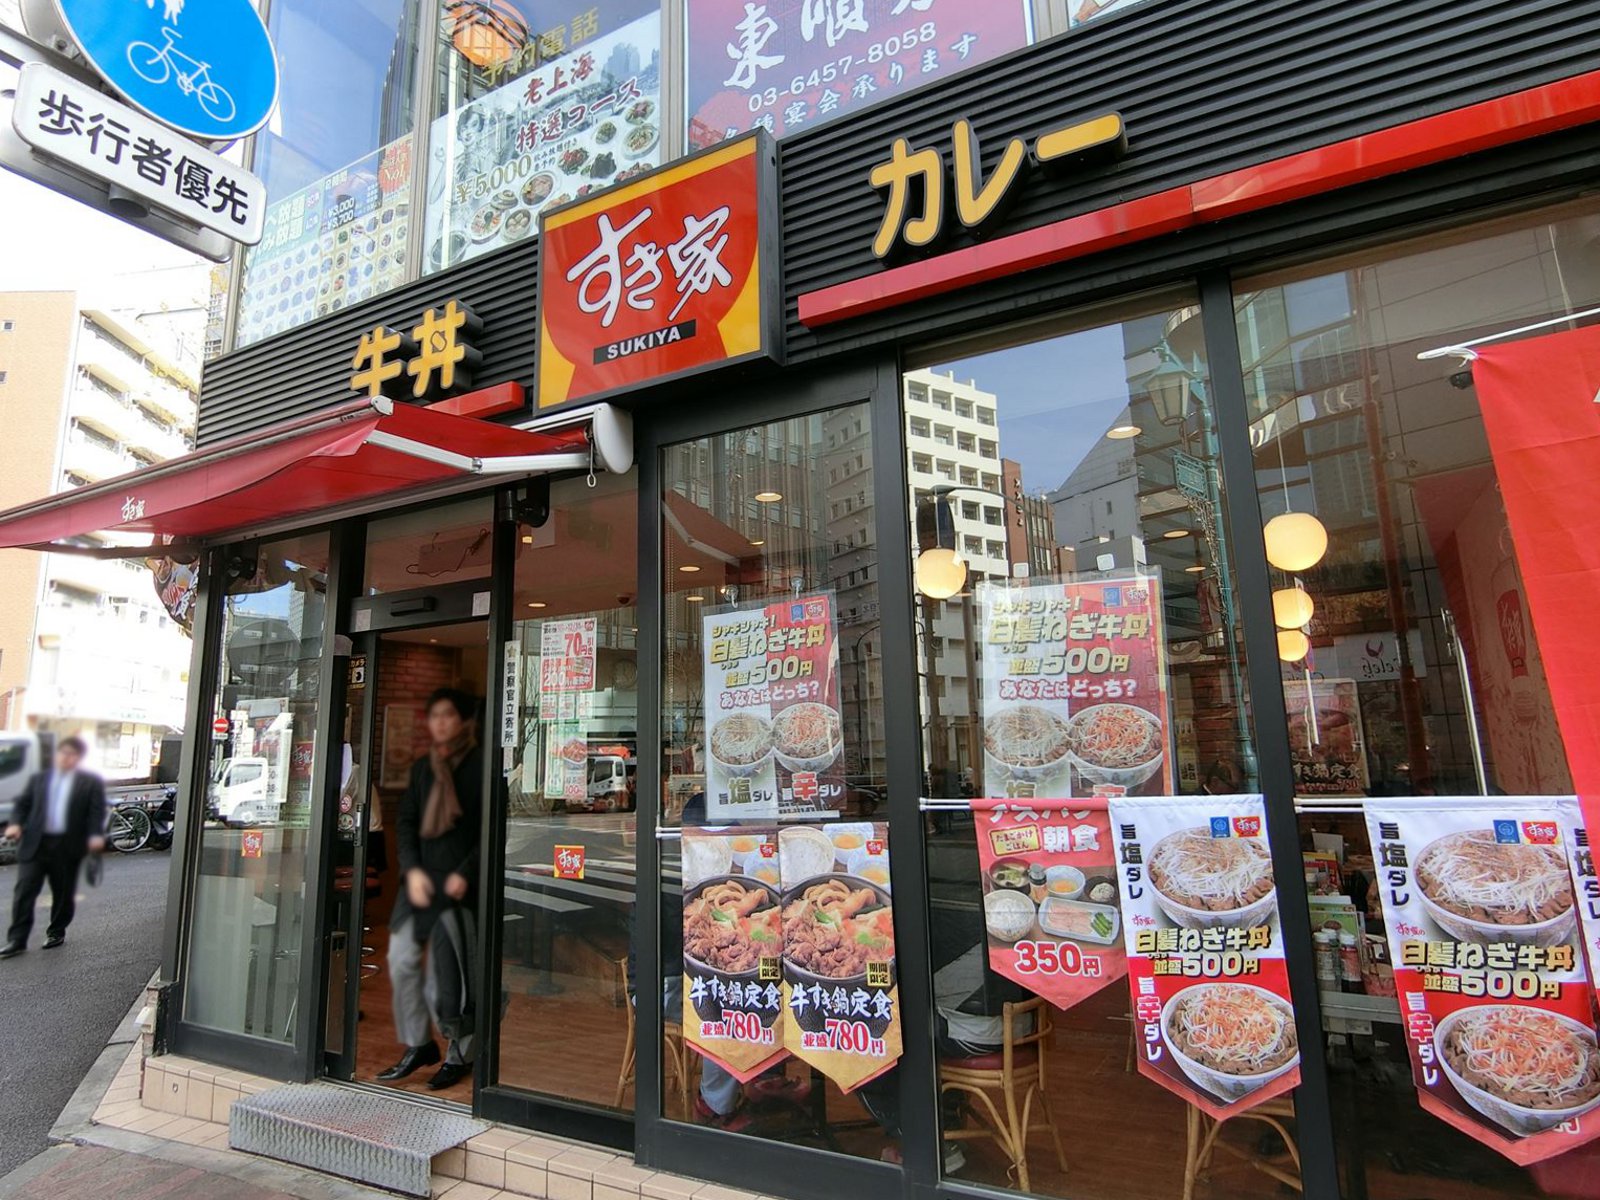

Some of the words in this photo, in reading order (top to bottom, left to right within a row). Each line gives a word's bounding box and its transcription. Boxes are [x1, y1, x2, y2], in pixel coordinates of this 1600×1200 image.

[724, 0, 934, 89] 東順
[523, 51, 595, 106] 老上海
[749, 22, 937, 112] 03-6457-8058
[515, 76, 642, 152] 特選コース
[38, 89, 249, 226] 歩行者優先
[868, 111, 1123, 258] カレー
[566, 205, 733, 328] すき家
[351, 299, 467, 399] 牛丼
[606, 326, 682, 360] SUKIYA
[710, 625, 826, 664] 白髪ねぎ牛丼
[987, 612, 1151, 646] 白髪ねぎ牛丼
[725, 655, 814, 688] 並盛500円
[1009, 646, 1130, 676] 並盛500円
[720, 680, 820, 709] あなたはどっち?
[999, 678, 1139, 700] あなたはどっち?
[1042, 824, 1101, 853] 朝食
[557, 848, 581, 870] すき家
[1120, 823, 1143, 900] 旨塩ダレ
[1379, 821, 1411, 907] 旨塩ダレ
[1013, 940, 1102, 977] 350円
[1134, 925, 1271, 954] 白髪ねぎ牛丼
[1401, 940, 1576, 973] 白髪ねぎ牛丼
[1153, 952, 1261, 978] 並盛500円
[688, 975, 784, 1011] 牛すき鍋定食
[789, 982, 894, 1021] 牛すき鍋定食
[1423, 971, 1561, 1000] 並盛500円
[700, 1009, 775, 1045] 並盛780円
[801, 1018, 886, 1057] 並盛780円
[1136, 977, 1162, 1061] 旨辛ダレ
[1405, 991, 1439, 1086] 旨辛ダレ
